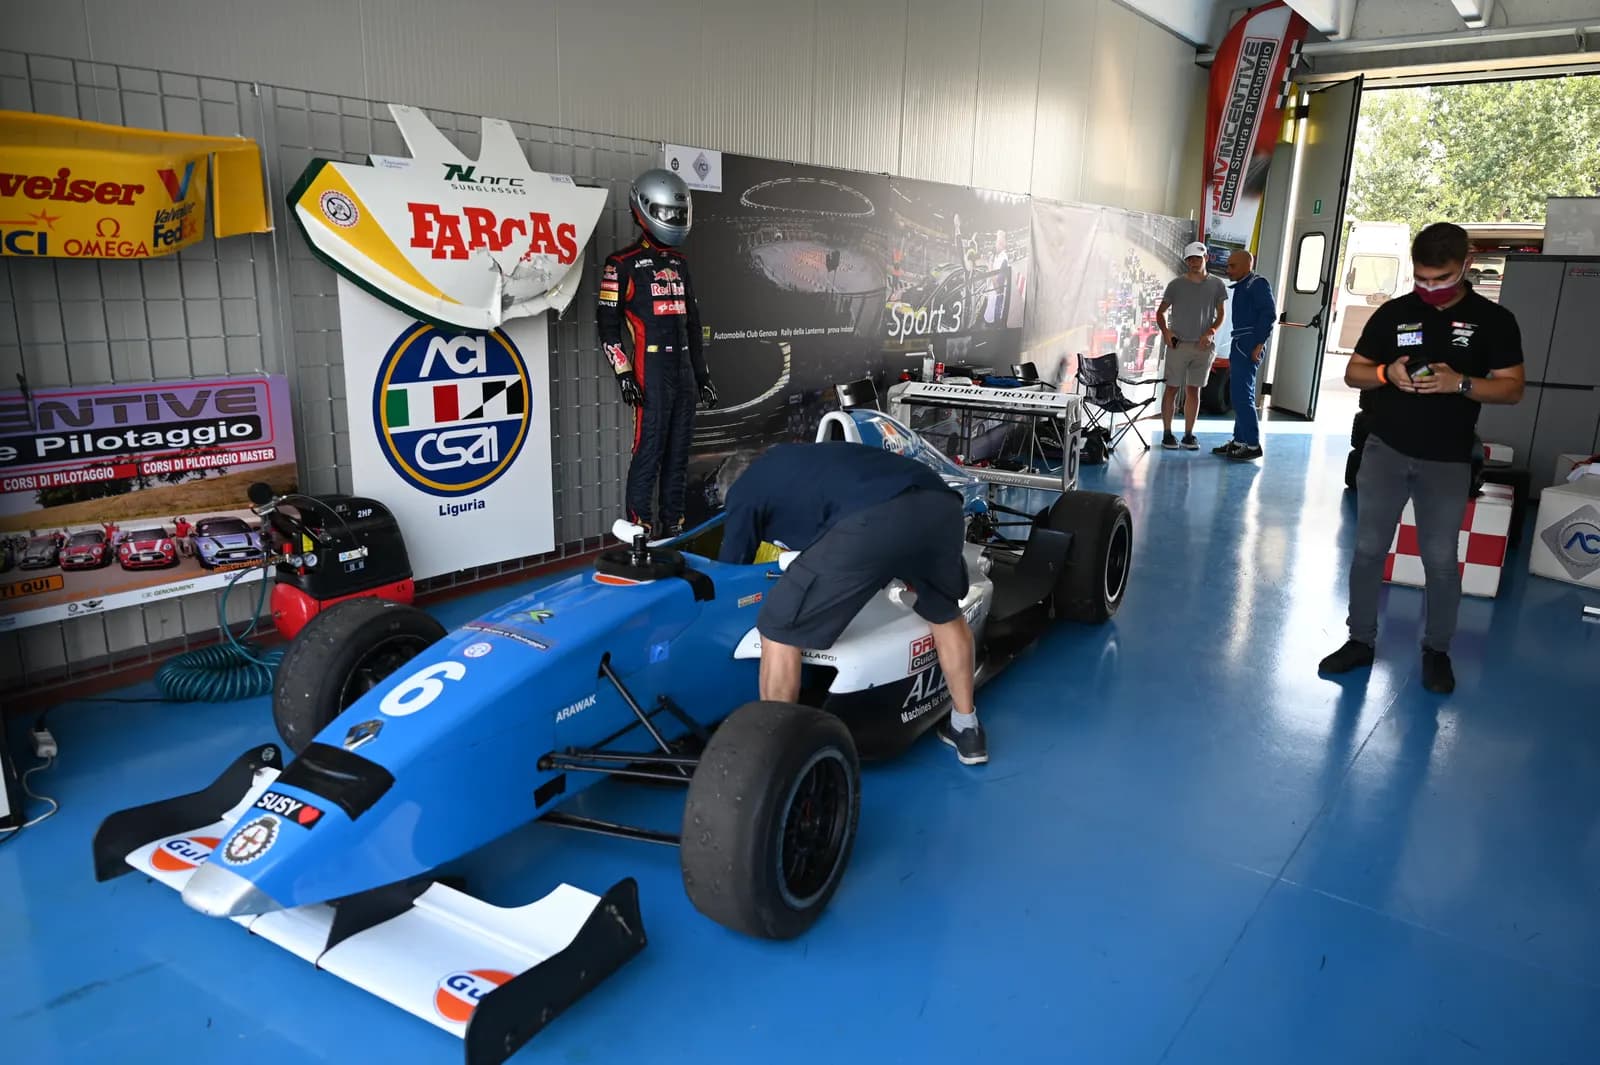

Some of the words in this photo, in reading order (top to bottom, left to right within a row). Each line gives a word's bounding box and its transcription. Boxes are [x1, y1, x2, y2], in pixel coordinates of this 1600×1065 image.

[1245, 46, 1272, 113] Pilotaggio
[1244, 117, 1253, 125] e
[1231, 128, 1250, 170] Sicura
[451, 183, 527, 196] SUNGLASSES
[1221, 173, 1238, 211] Guida
[0, 229, 48, 256] CI
[63, 238, 150, 258] OMEGA
[650, 282, 670, 297] Red
[714, 330, 746, 340] Automobile
[746, 328, 759, 339] Club
[759, 328, 778, 338] Genova
[780, 326, 793, 337] Rally
[793, 326, 805, 336] della
[805, 325, 825, 335] Lanterna
[887, 302, 946, 345] Sport
[952, 301, 962, 333] 3
[418, 335, 487, 378] ACI
[922, 384, 988, 396] HISTORIC
[993, 389, 1060, 402] PROJECT
[35, 420, 253, 457] Pilotaggio
[143, 461, 172, 474] CORSI
[174, 458, 185, 469] DI
[186, 453, 239, 469] PILOTAGGIO
[240, 448, 275, 463] MASTER
[3, 476, 37, 491] CORSI
[40, 474, 52, 487] DI
[53, 467, 115, 485] PILOTAGGIO
[357, 508, 373, 519] 2HP
[438, 498, 486, 517] Liguria
[20, 578, 50, 594] QUI
[378, 660, 467, 717] 6
[555, 693, 597, 724] ARAWAK
[900, 702, 932, 724] Machines
[931, 692, 942, 708] for
[257, 792, 303, 817] SUSY
[165, 839, 211, 865] Gul
